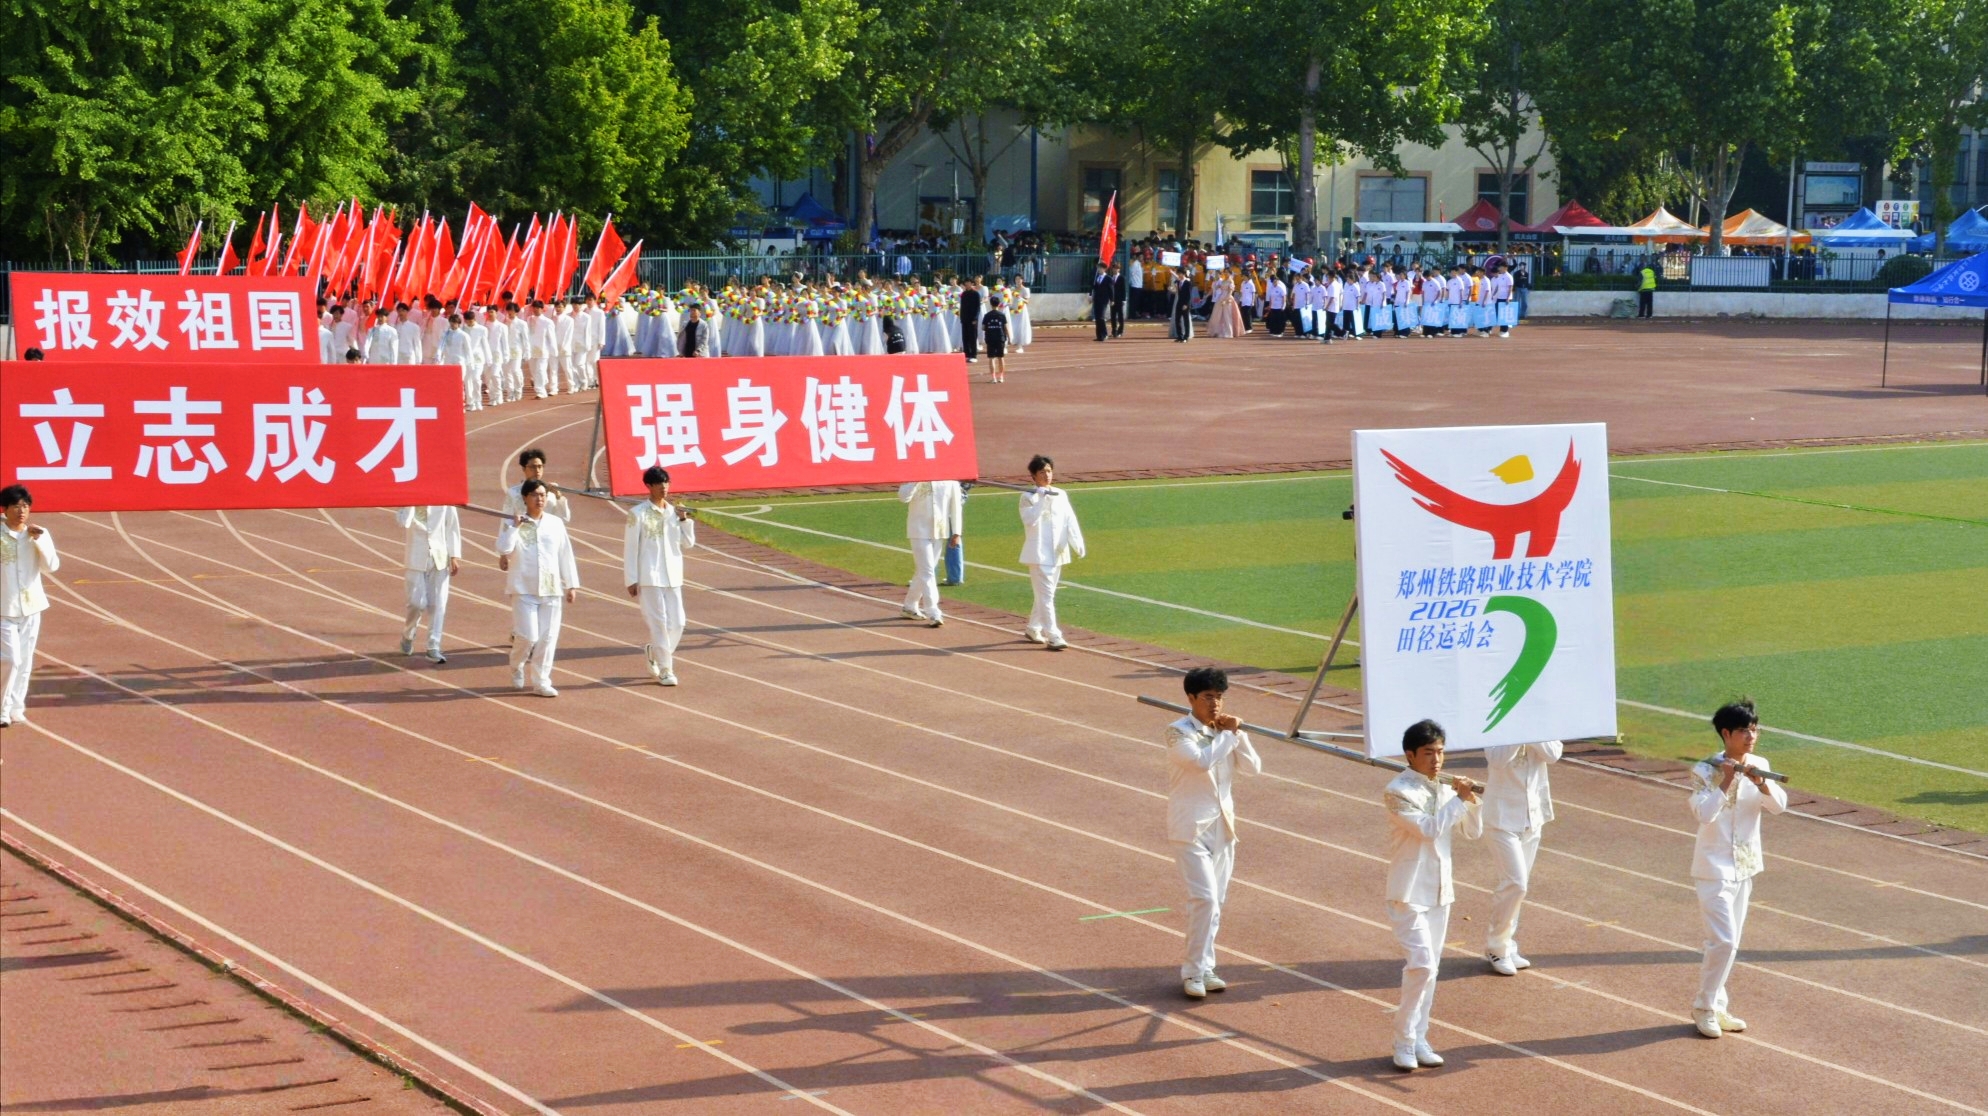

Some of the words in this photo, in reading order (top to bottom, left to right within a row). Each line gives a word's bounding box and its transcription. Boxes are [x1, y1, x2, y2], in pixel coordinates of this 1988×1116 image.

[34, 288, 304, 352] 报效祖国
[16, 387, 438, 484] 立志成才
[626, 374, 954, 471] 强身健体
[1395, 558, 1593, 599] 郑州铁路职业技术学院
[1396, 619, 1496, 652] 田径运动会
[1410, 599, 1479, 621] 2026
